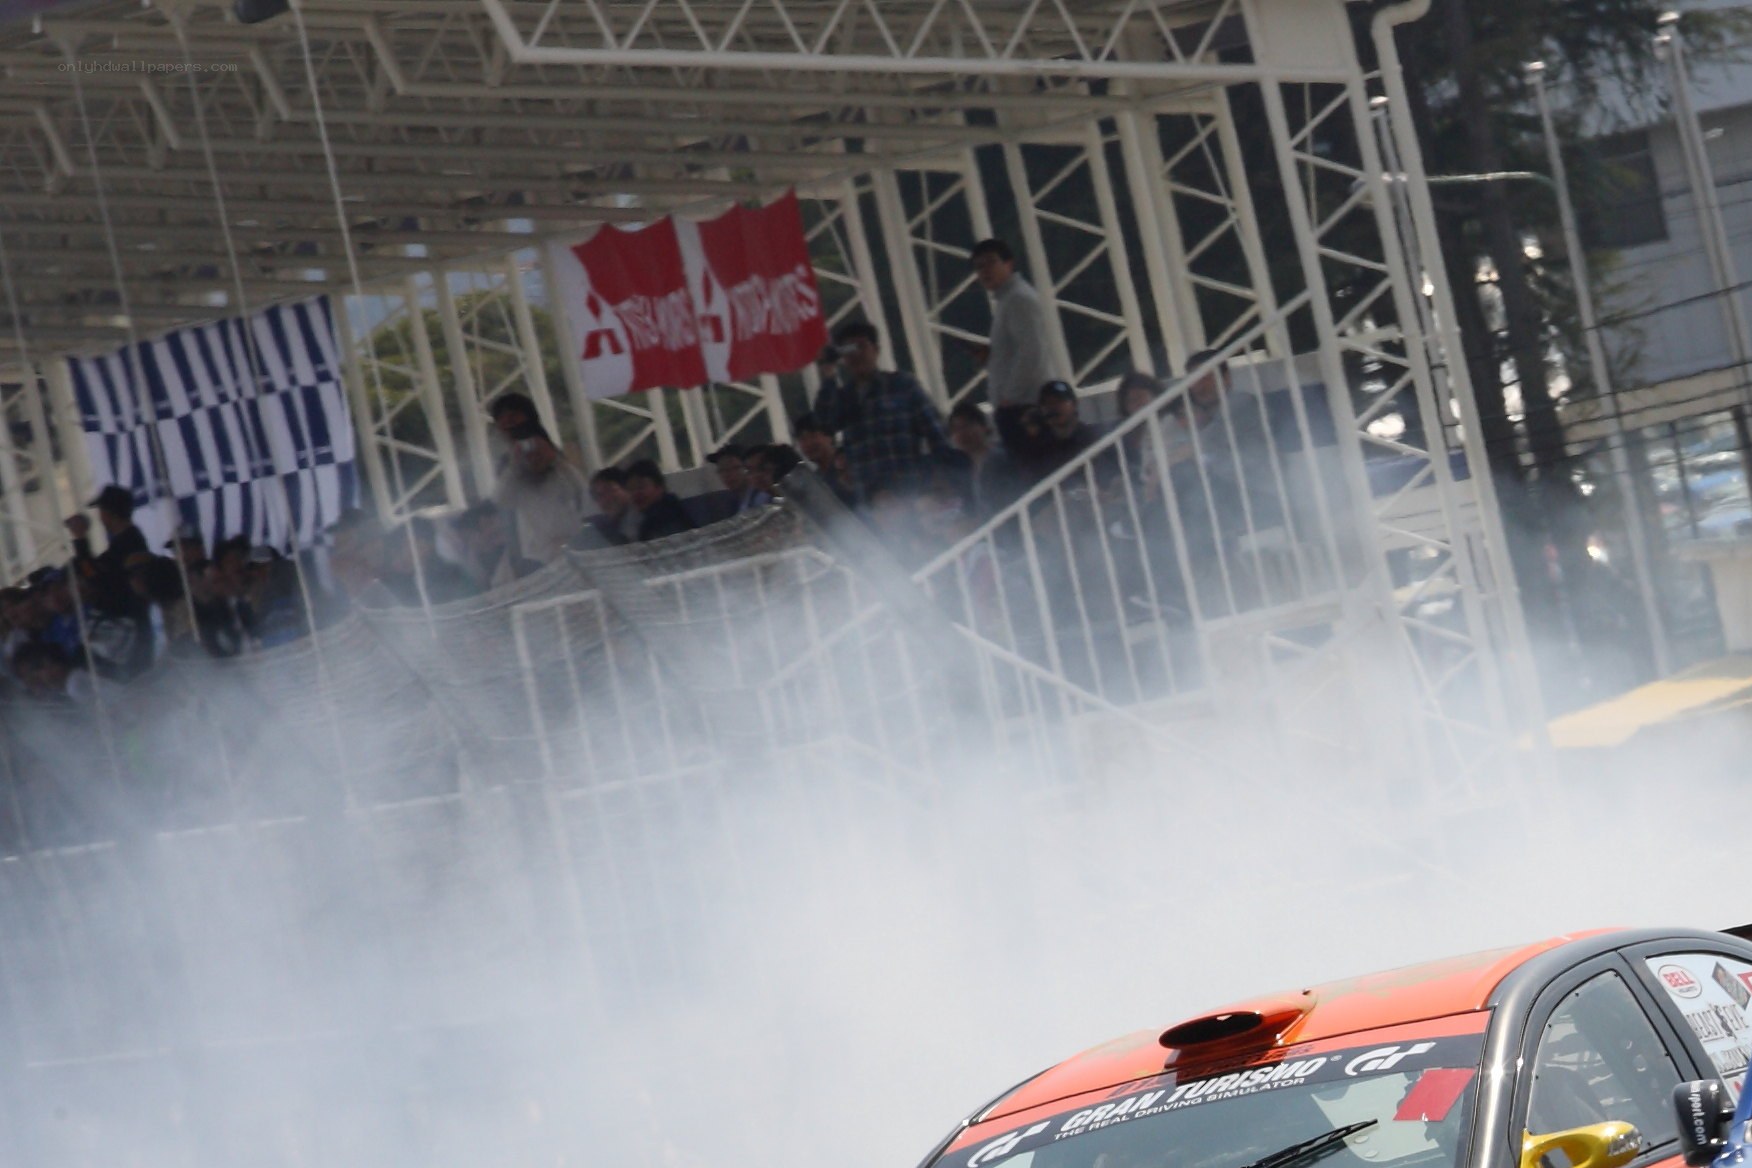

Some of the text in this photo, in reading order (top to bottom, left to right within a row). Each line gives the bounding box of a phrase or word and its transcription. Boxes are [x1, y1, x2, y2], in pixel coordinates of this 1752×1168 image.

[1054, 1077, 1305, 1140] THE REAL DRIVING SIMULATOR
[1061, 1057, 1326, 1132] GRAN TURISMO
